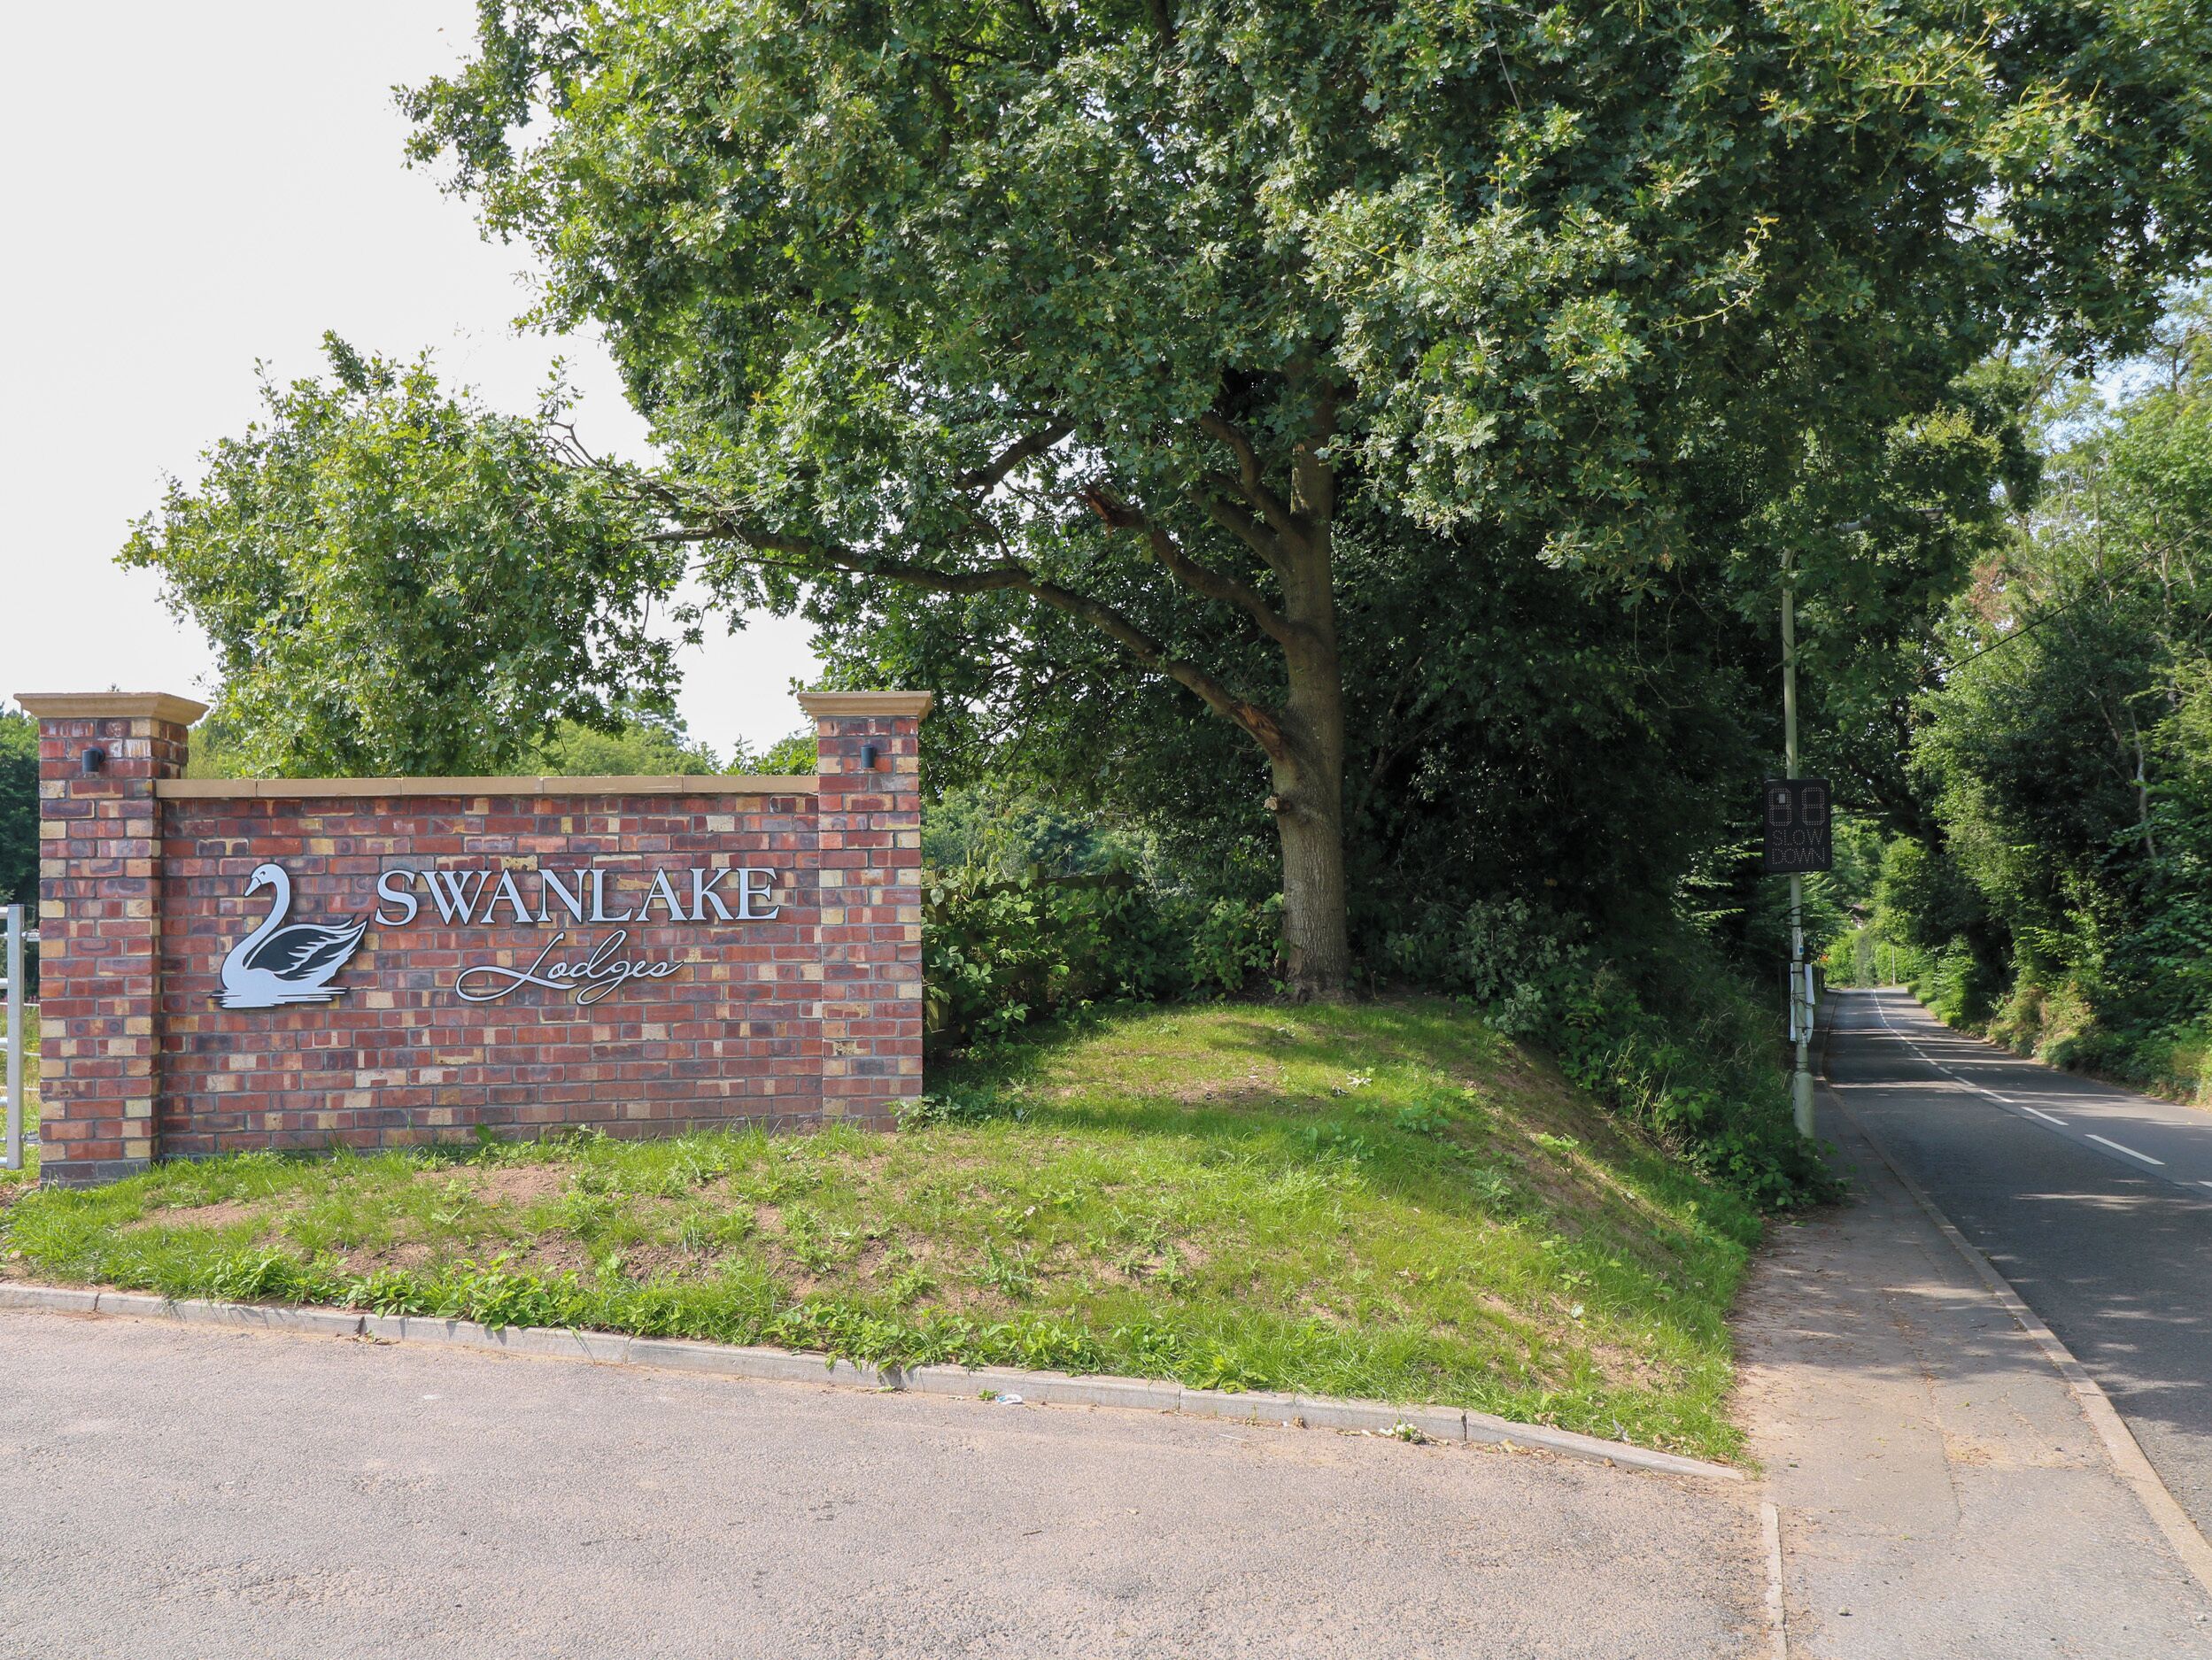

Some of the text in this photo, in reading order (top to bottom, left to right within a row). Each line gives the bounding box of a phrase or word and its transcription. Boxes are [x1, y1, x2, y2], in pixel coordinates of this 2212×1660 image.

[1772, 847, 1825, 864] DOWN
[1773, 829, 1823, 845] SLOW
[375, 867, 781, 926] SWANLAKE
[454, 929, 684, 1005] Lodges
